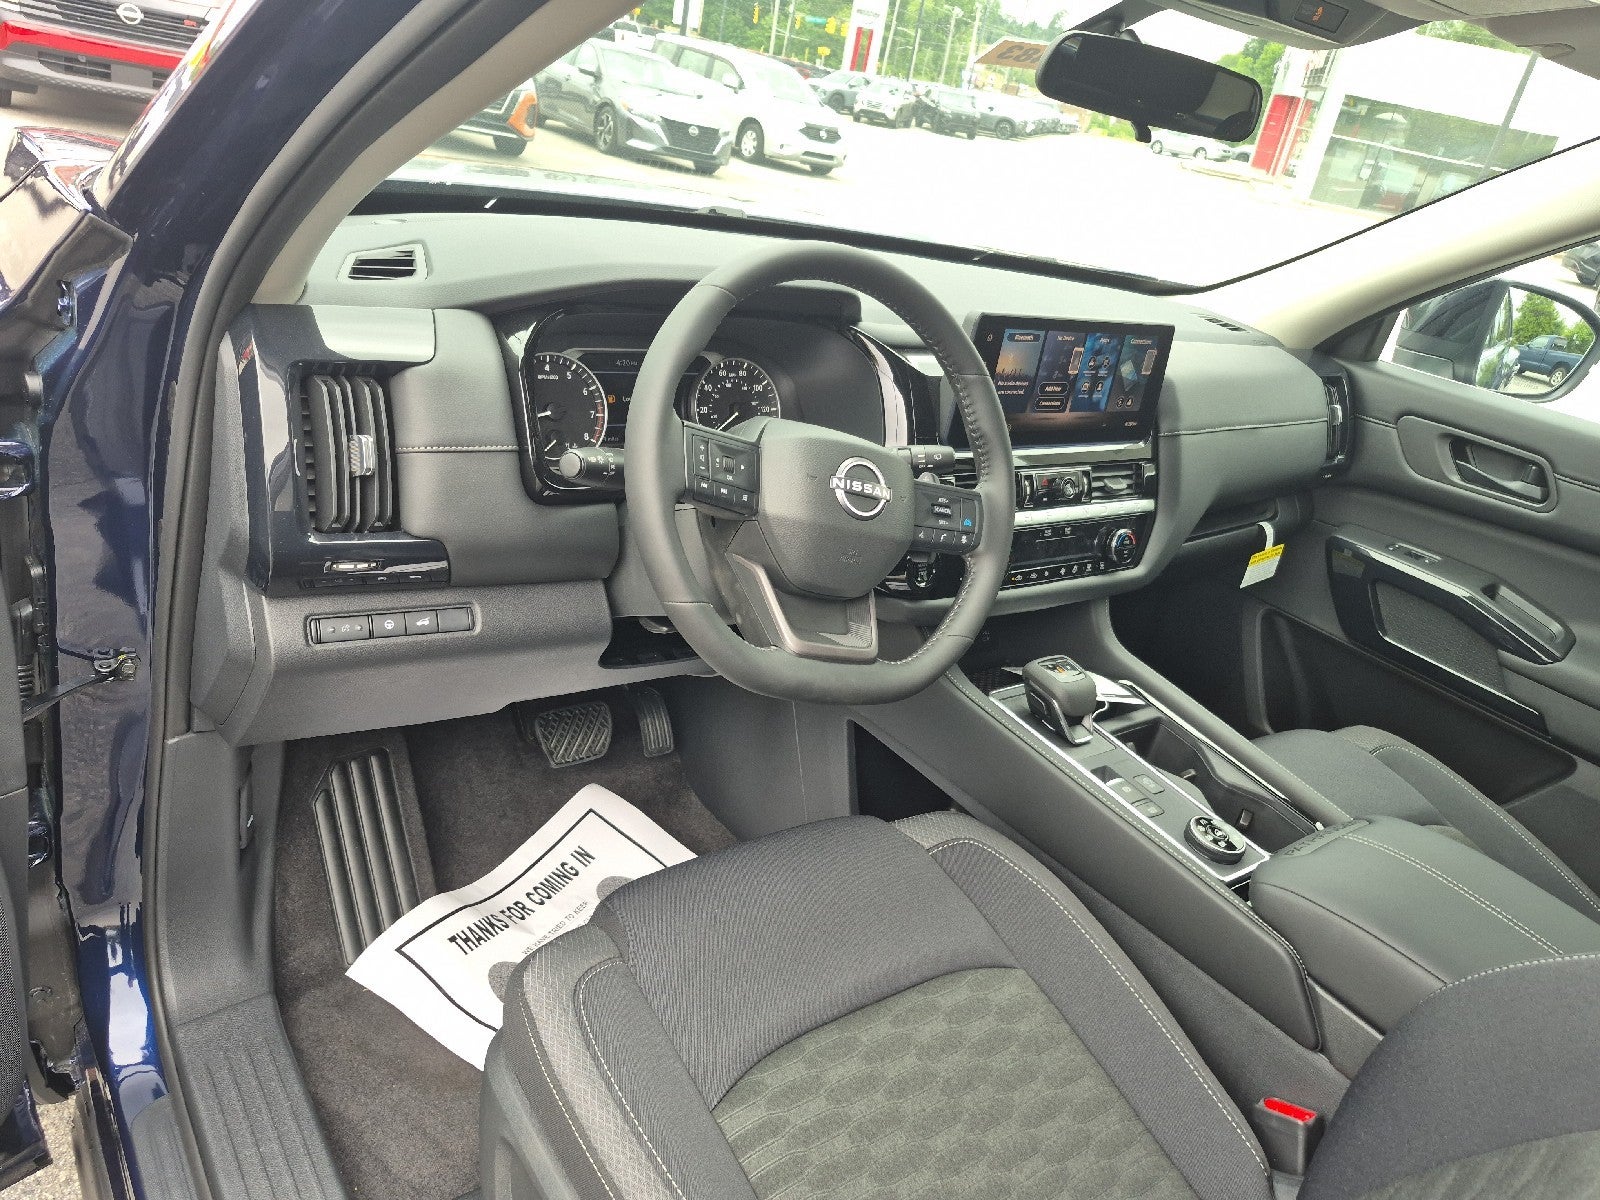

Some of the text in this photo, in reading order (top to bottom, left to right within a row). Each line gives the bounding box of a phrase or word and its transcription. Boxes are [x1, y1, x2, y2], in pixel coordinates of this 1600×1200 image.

[566, 371, 572, 380] 5
[582, 387, 588, 396] 6
[589, 410, 595, 419] 7
[699, 406, 708, 414] 20
[583, 432, 590, 441] 8
[832, 477, 891, 501] NISSAN
[447, 845, 595, 955] THANKS FOR COMING IN
